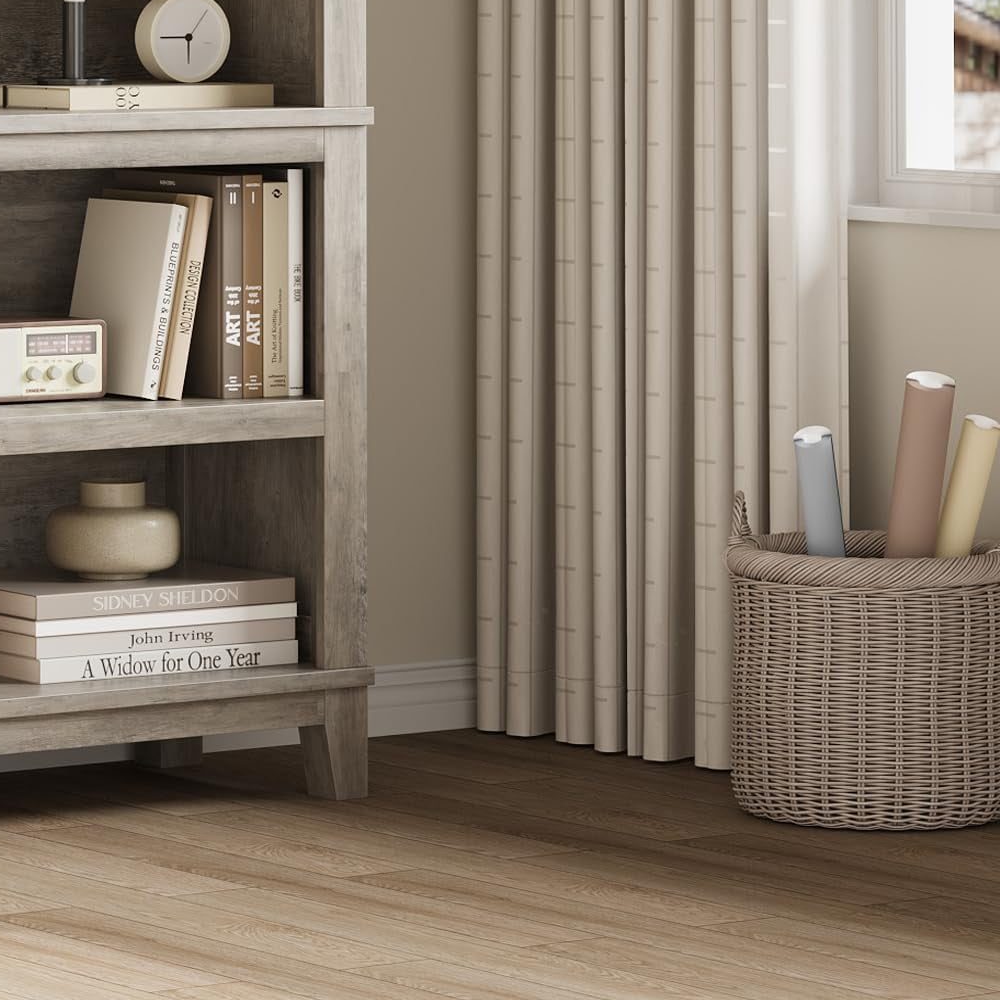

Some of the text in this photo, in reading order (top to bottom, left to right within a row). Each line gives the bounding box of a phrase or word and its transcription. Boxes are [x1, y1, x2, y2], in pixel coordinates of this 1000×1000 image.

[162, 242, 180, 305] BLUEPRINTS
[179, 260, 201, 335] DESIGN COLLECTION
[152, 318, 167, 371] BUILDINGS
[225, 311, 241, 346] ART
[246, 310, 261, 345] ART
[93, 586, 239, 611] SIDNEY SHELDON
[128, 630, 214, 649] John Irving
[81, 648, 261, 679] A Widow for One Year
